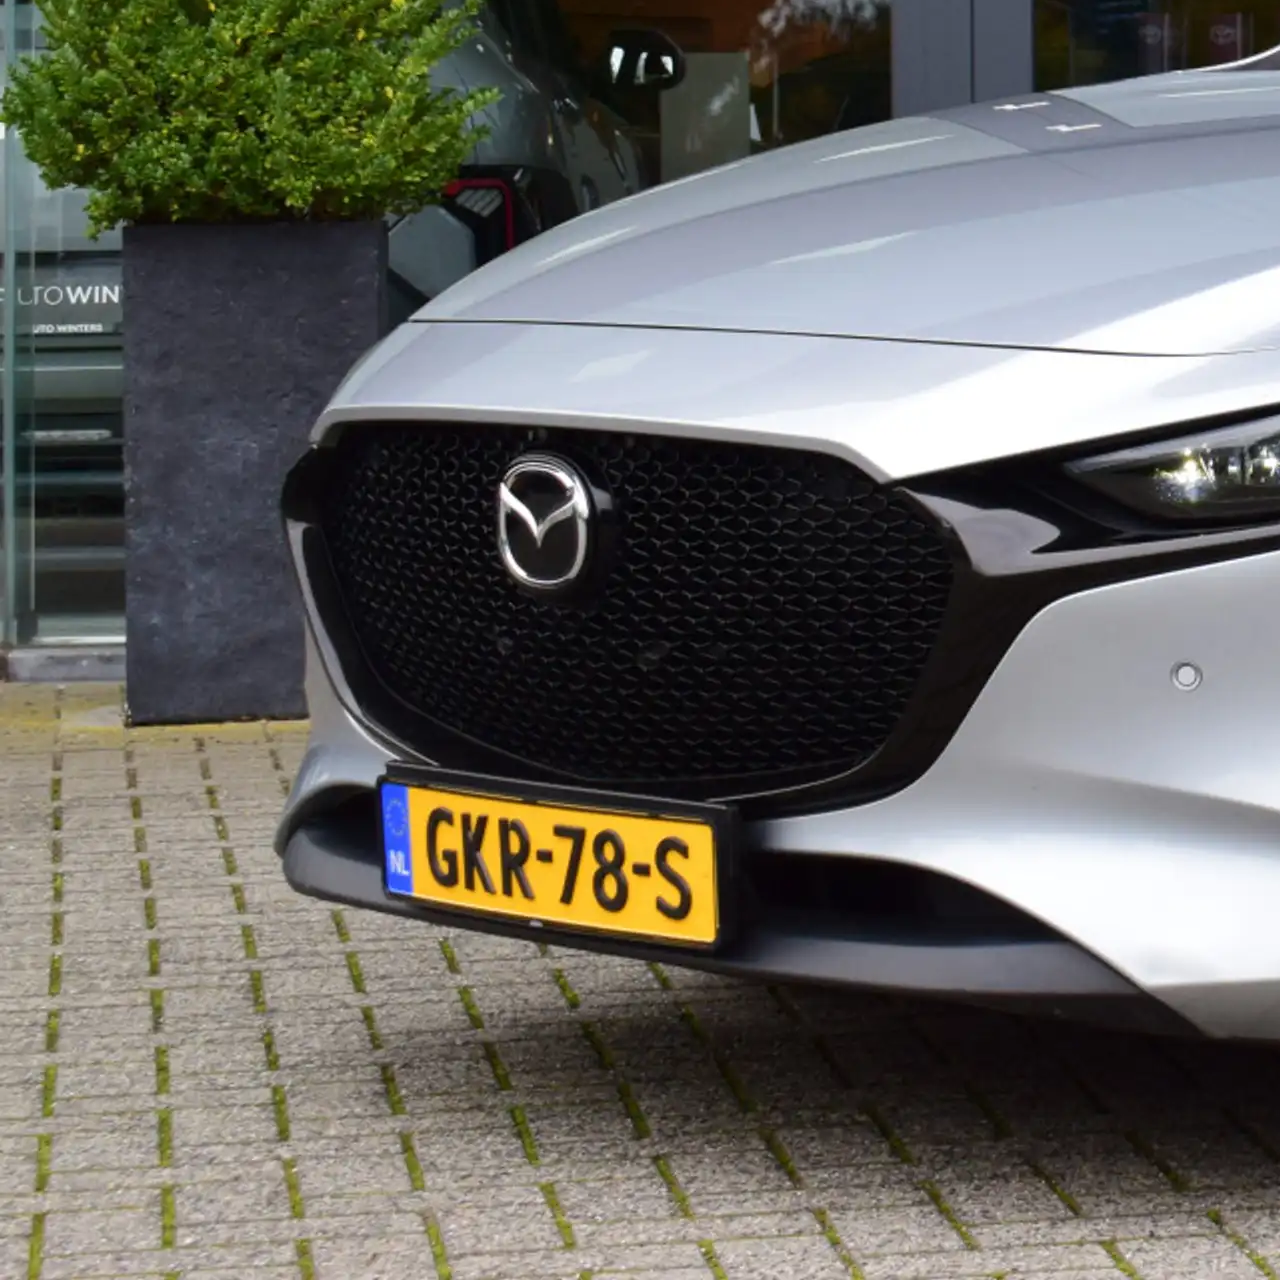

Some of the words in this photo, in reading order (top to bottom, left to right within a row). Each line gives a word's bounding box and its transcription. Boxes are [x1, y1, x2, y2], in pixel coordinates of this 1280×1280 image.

[17, 285, 122, 306] UTOWIN
[388, 849, 411, 877] NL
[425, 806, 693, 922] GKR-78-S
